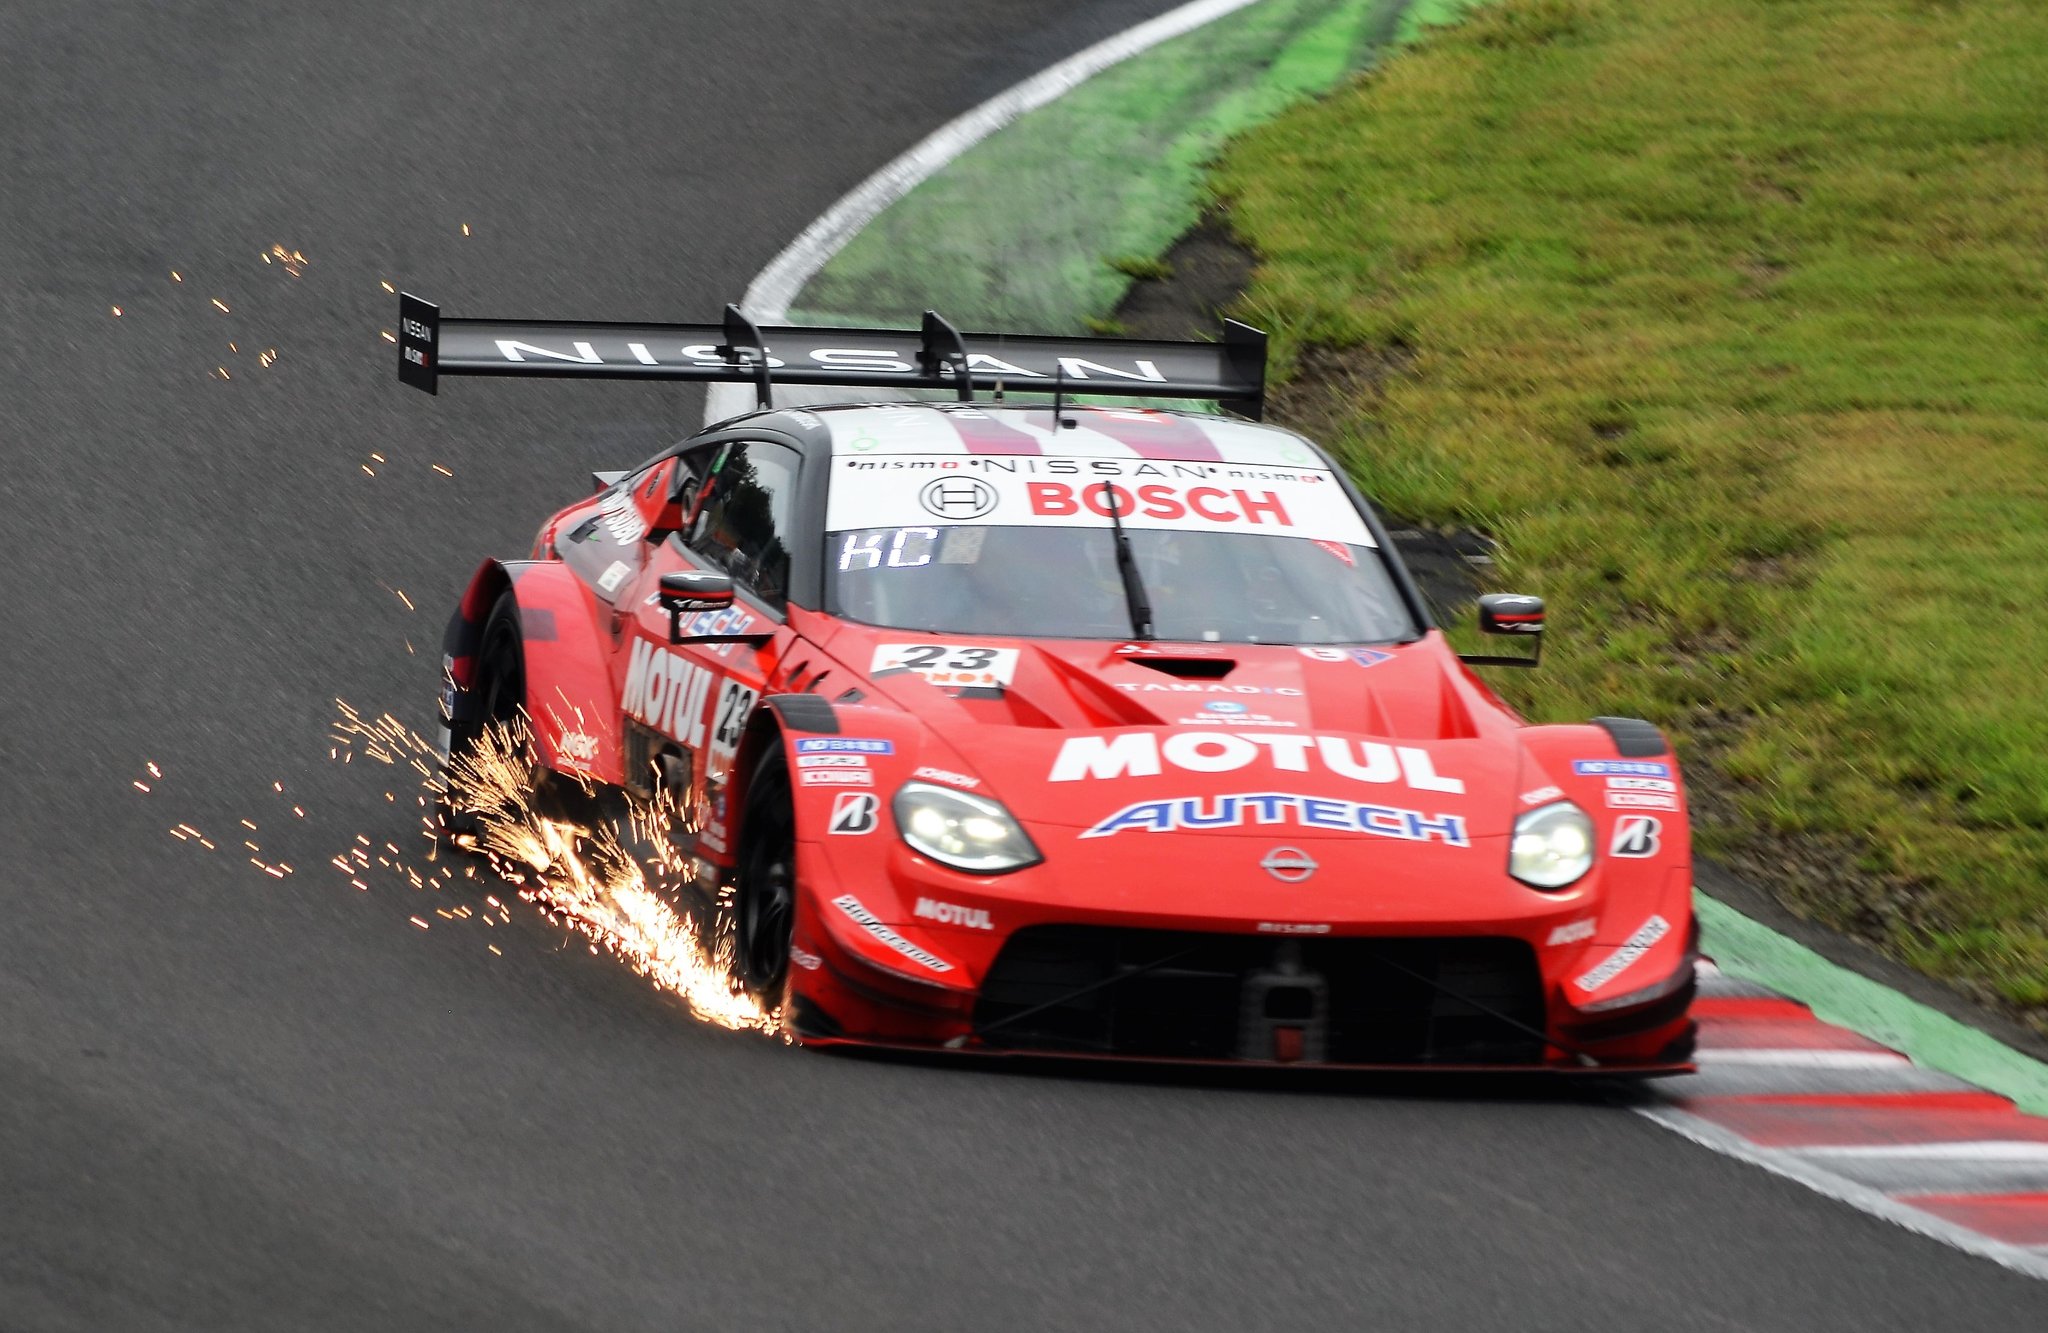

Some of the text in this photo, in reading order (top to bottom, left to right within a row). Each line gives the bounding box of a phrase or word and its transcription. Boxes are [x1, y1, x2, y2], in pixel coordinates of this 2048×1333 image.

[494, 339, 1168, 383] NISSAN
[859, 458, 1318, 484] nismo NISSAN nismo
[1026, 481, 1295, 527] BOSCH
[901, 645, 999, 670] 23
[620, 635, 714, 749] MOTUL
[716, 683, 752, 748] 23
[1047, 730, 1467, 795] MOTUL
[1077, 791, 1472, 848] AUTECH
[913, 896, 995, 930] MOTUL
